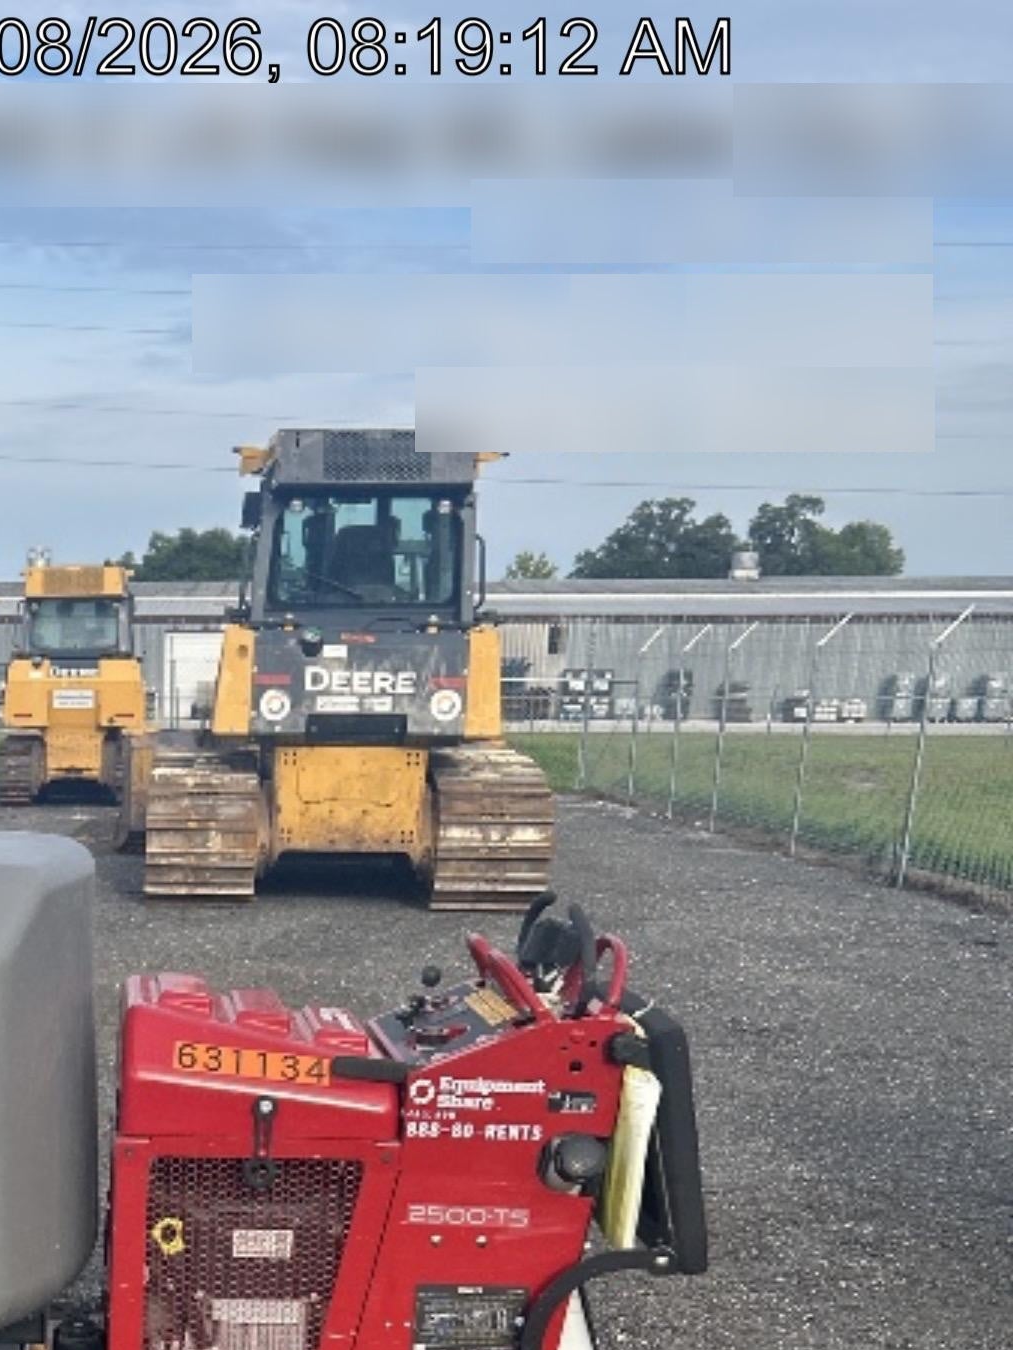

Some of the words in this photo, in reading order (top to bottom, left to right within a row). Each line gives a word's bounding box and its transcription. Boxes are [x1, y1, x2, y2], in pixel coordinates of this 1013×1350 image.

[304, 666, 416, 693] DEERE
[178, 1043, 327, 1083] 631134
[439, 1077, 546, 1095] Equipment
[408, 1204, 530, 1228] 2500-TS
